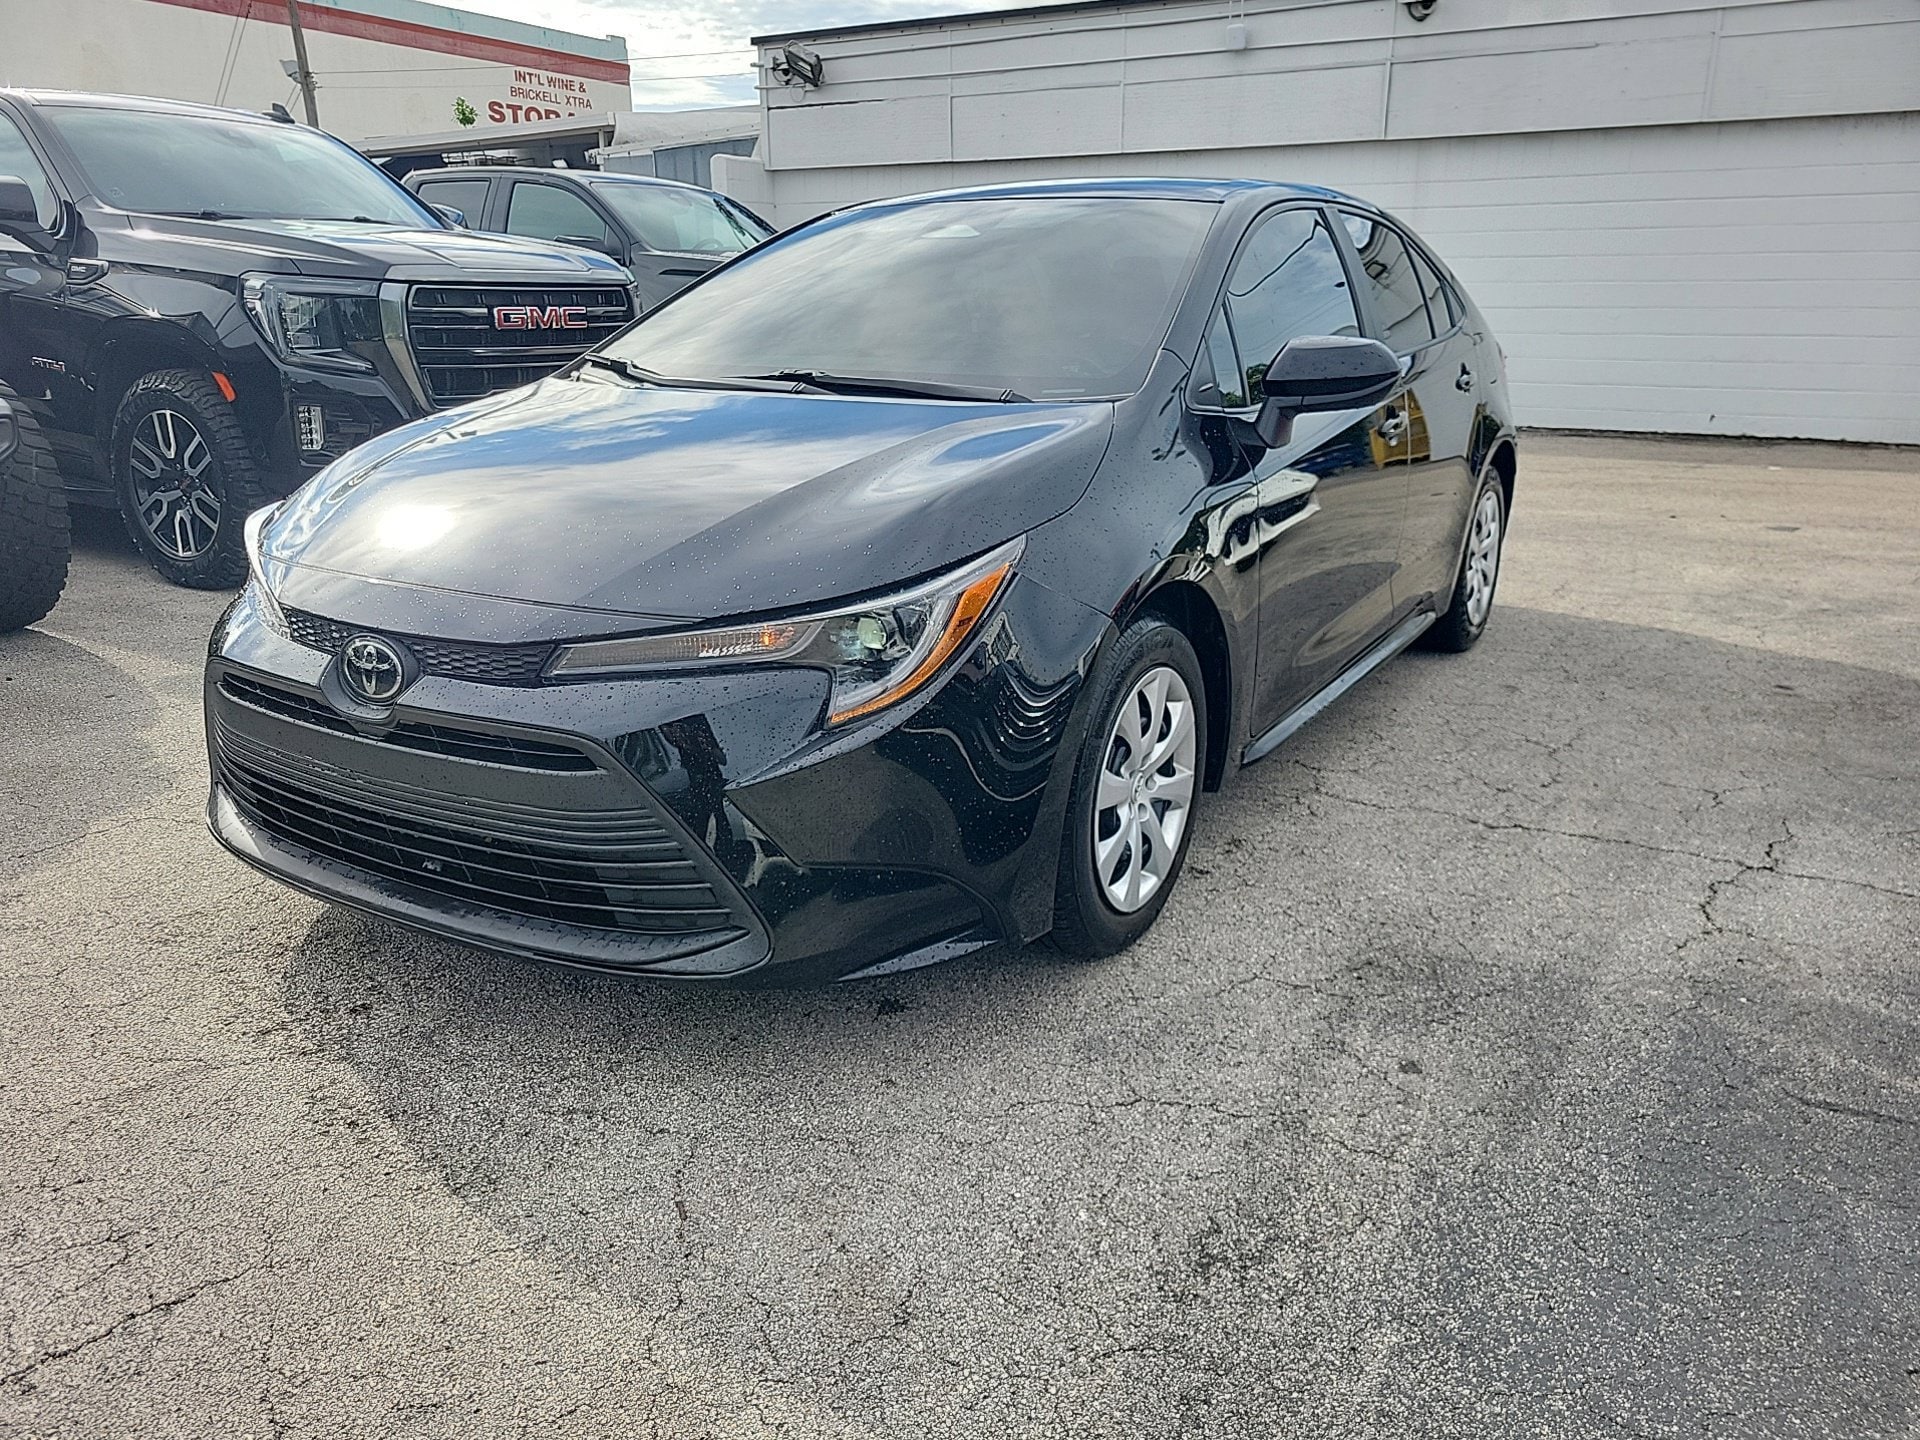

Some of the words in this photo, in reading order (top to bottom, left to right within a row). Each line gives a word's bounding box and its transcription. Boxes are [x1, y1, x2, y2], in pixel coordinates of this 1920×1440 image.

[514, 70, 545, 86] INT'L
[546, 76, 576, 93] WINE
[579, 82, 587, 93] &
[510, 86, 561, 105] BRICKELL
[565, 95, 593, 110] XTRA
[493, 306, 588, 330] GMC
